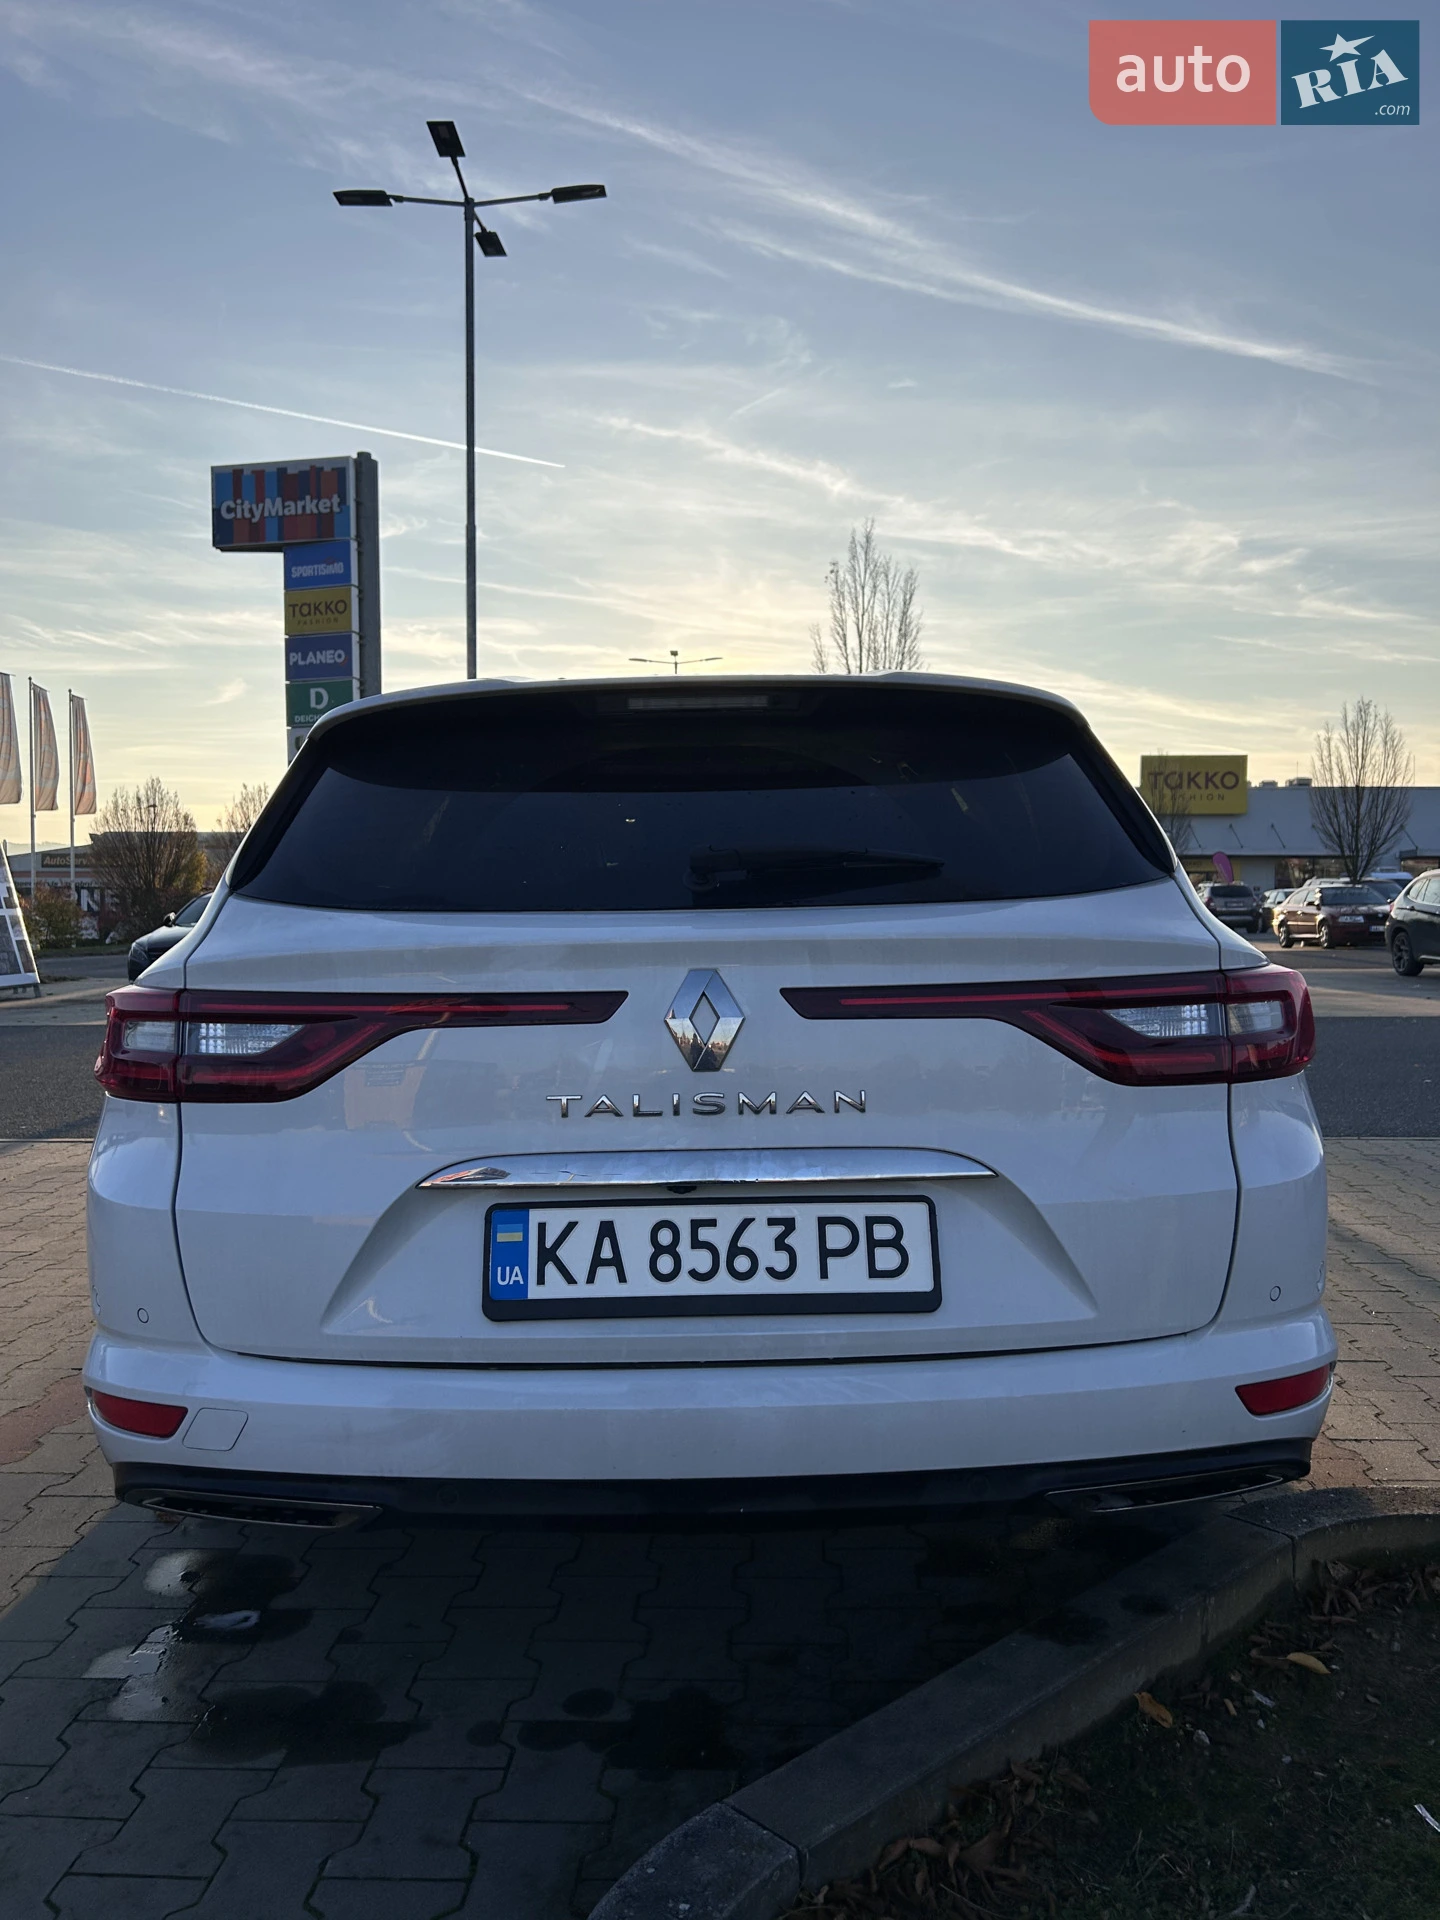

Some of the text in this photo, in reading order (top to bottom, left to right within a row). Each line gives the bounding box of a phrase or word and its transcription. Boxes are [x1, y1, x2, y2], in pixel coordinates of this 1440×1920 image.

[220, 493, 341, 523] CityMarket
[297, 617, 339, 626] FASHION
[289, 649, 345, 666] PLANEO
[310, 687, 329, 710] D
[546, 1089, 868, 1119] TALISMAN
[536, 1216, 909, 1286] KA 8563 PB
[497, 1266, 524, 1286] UA
